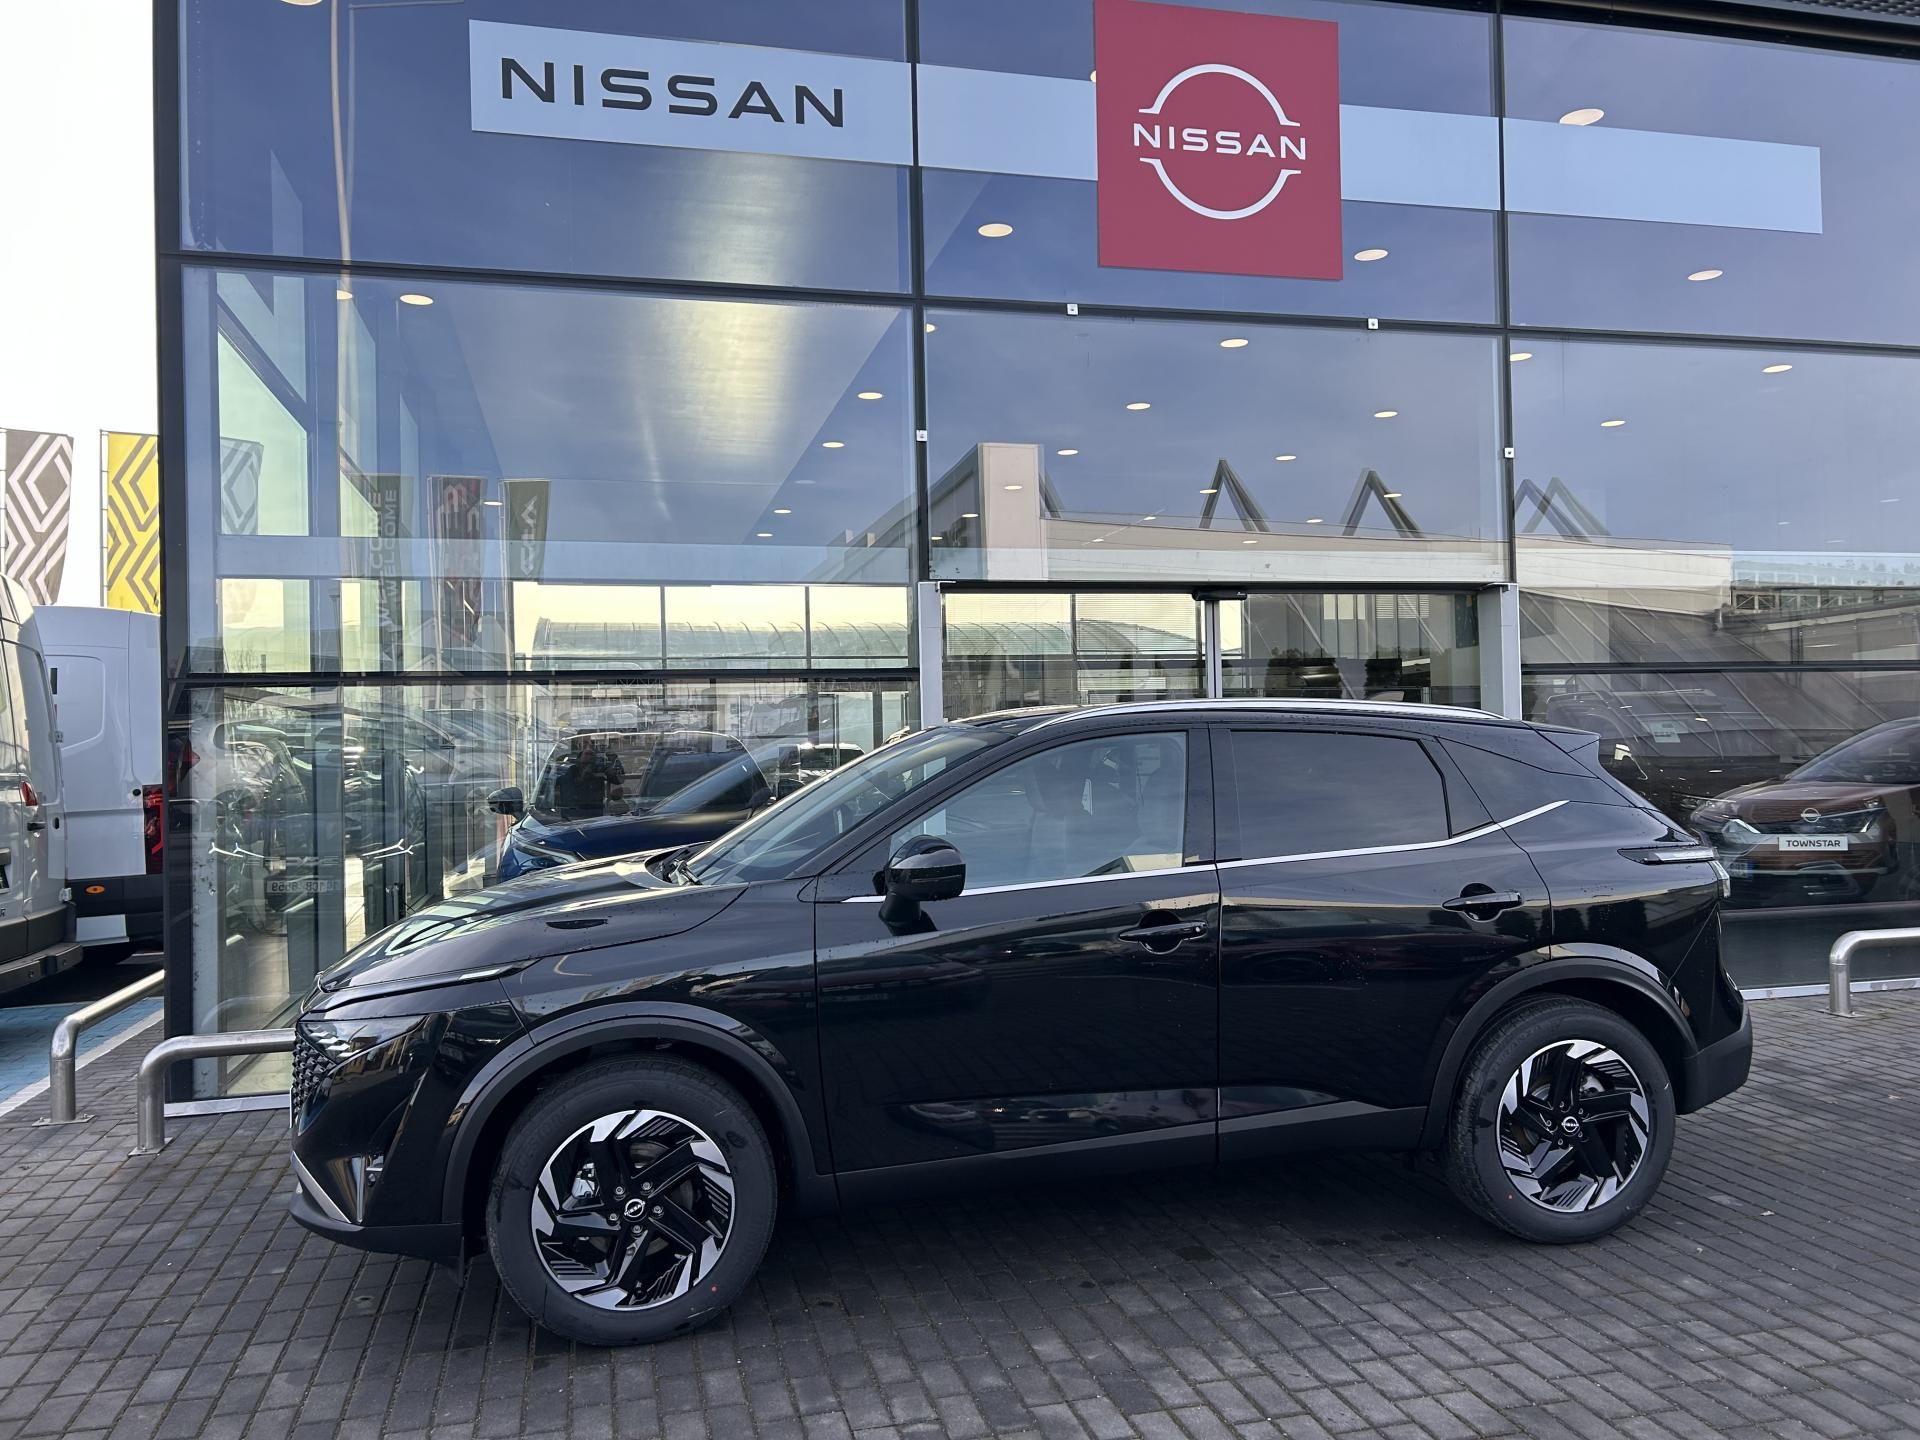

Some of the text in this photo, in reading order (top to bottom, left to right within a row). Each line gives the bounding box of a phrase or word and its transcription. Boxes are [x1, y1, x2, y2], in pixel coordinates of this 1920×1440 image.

[500, 56, 844, 128] NISSAN
[1132, 122, 1307, 161] NISSAN
[1785, 839, 1841, 848] TOWNSTAR
